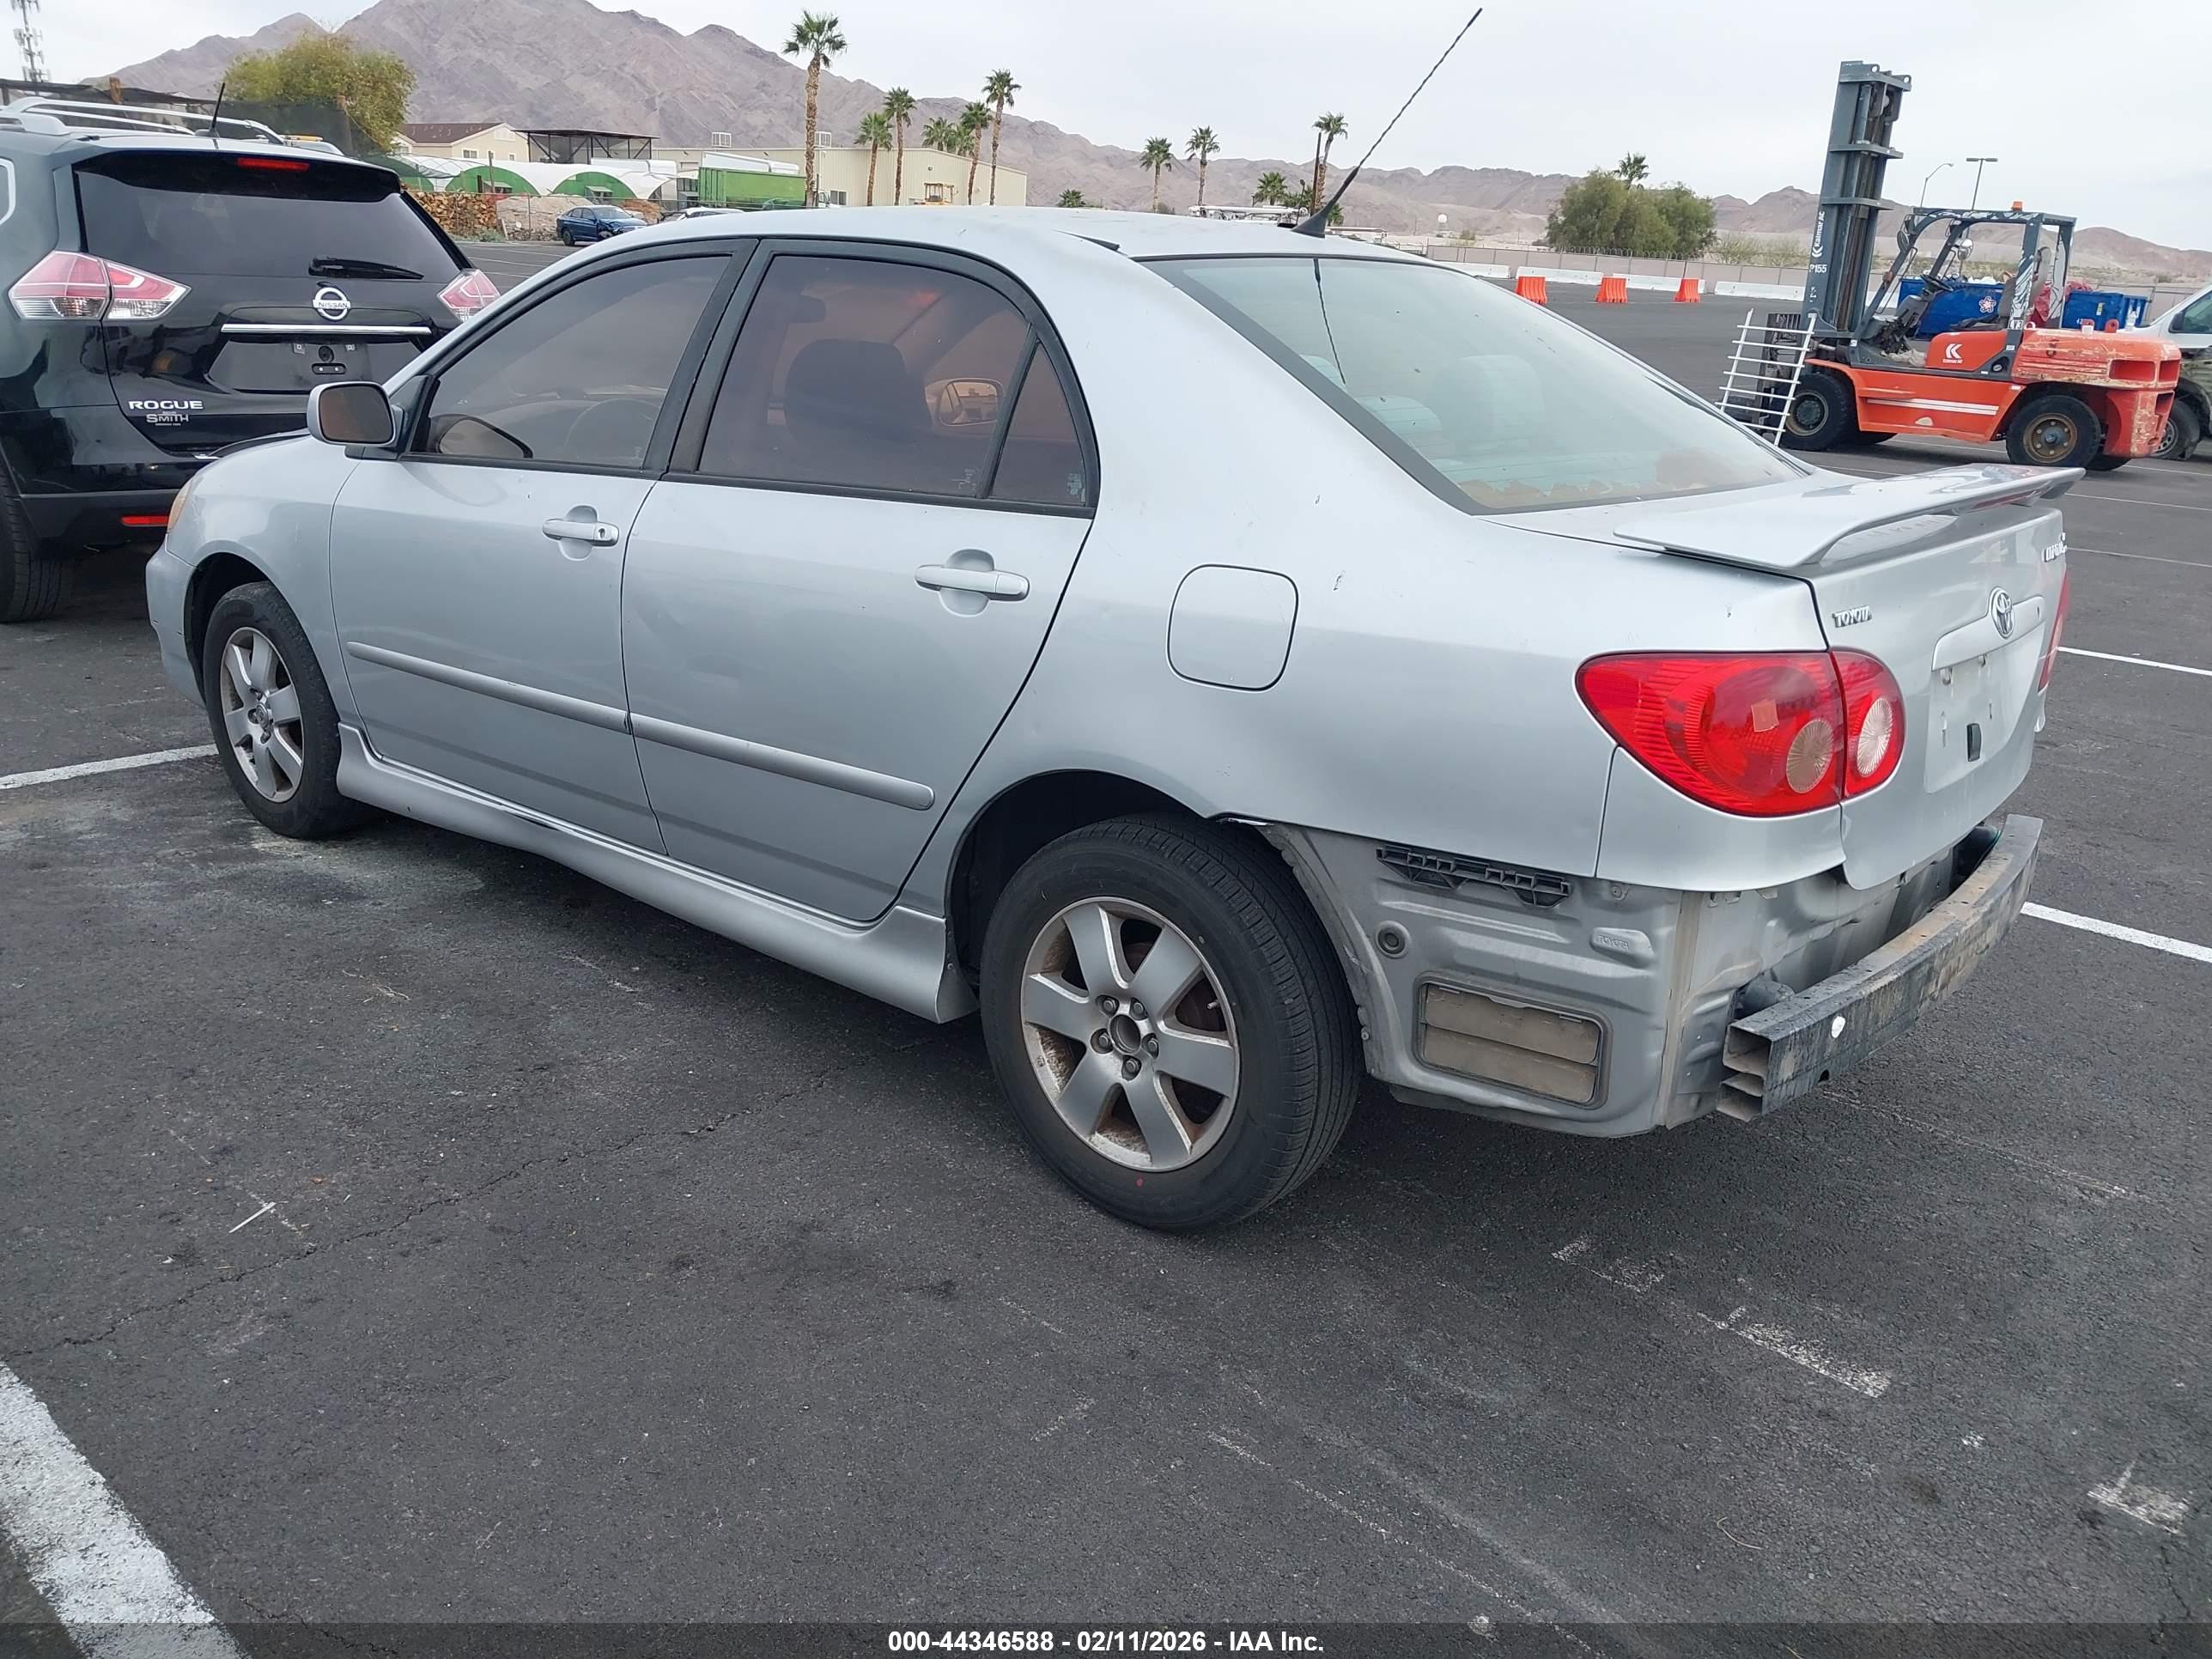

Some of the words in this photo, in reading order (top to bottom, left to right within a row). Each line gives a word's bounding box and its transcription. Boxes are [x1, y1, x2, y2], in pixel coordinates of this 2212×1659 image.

[1818, 210, 1826, 222] AC
[1814, 222, 1824, 247] Kalmar
[128, 400, 204, 410] ROGUE
[1832, 605, 1871, 628] TOYOTA
[1597, 934, 1629, 950] TOYOTA
